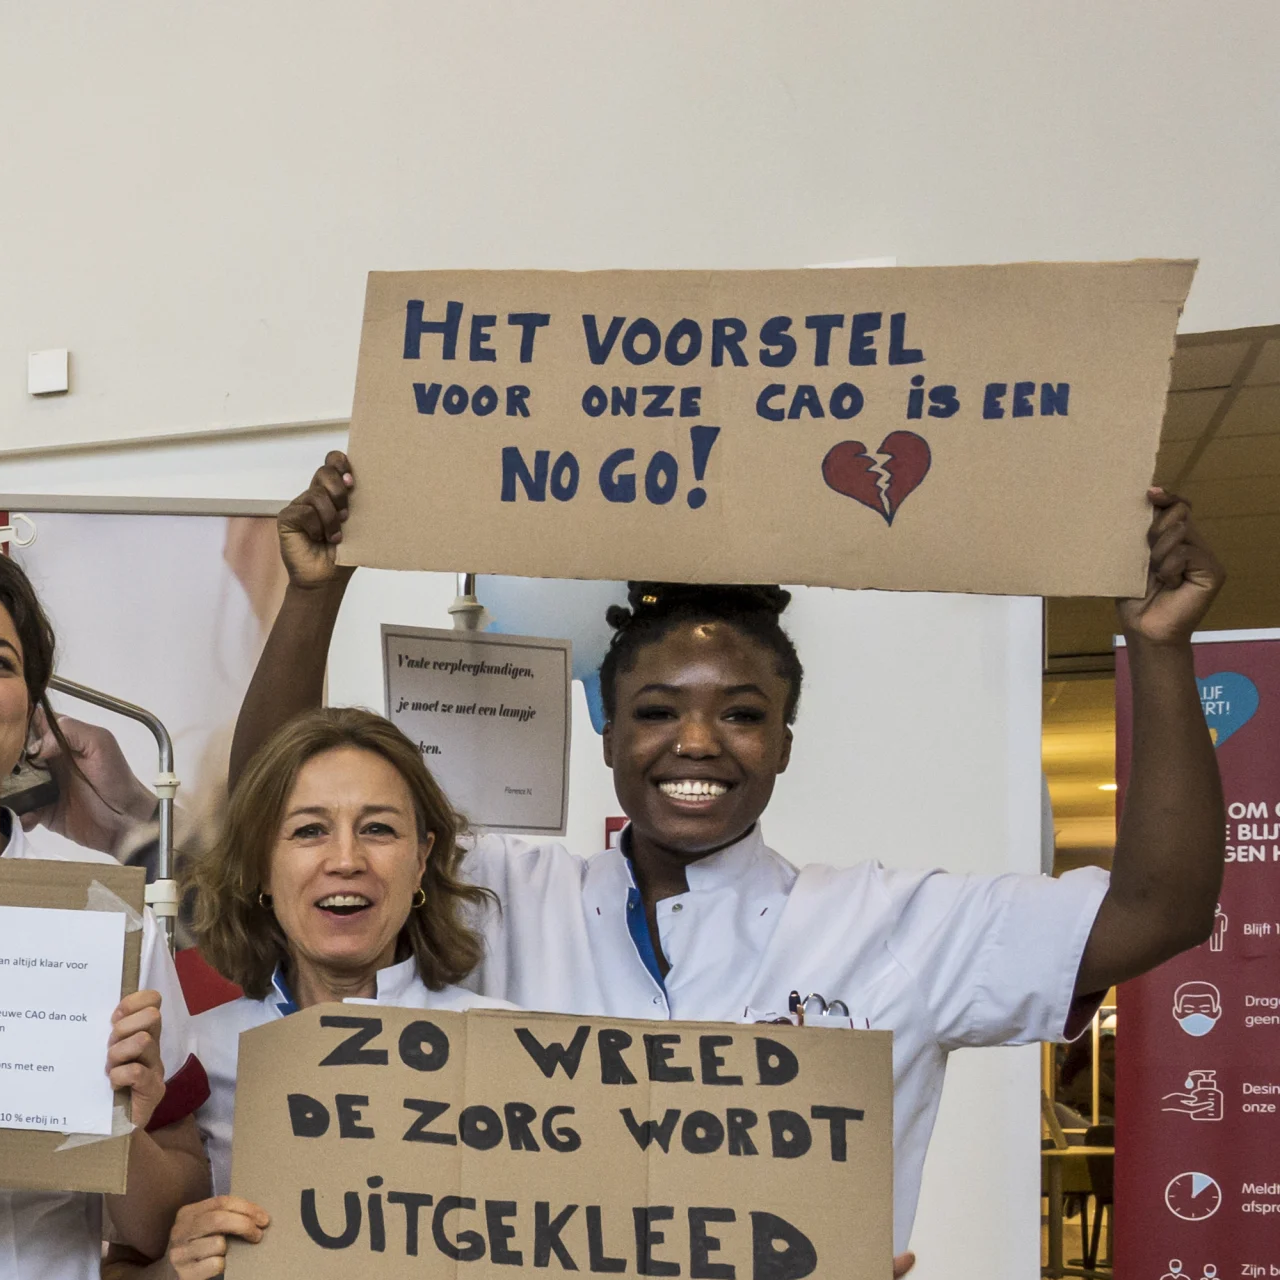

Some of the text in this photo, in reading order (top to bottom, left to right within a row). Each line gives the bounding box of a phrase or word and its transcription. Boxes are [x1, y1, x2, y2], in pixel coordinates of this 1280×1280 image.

[581, 312, 926, 367] VOORSTEL
[412, 382, 531, 418] VOOR
[581, 385, 702, 418] ONZE
[755, 382, 865, 421] CAO
[982, 383, 1070, 420] EEN
[501, 425, 721, 510] NO GO!
[398, 654, 534, 679] Vaste verpleegkundigen,
[396, 697, 536, 722] je moet ze met een lampje
[1228, 802, 1268, 819] OM
[1238, 823, 1280, 840] BLIJ
[1243, 923, 1271, 938] Blijft
[13, 957, 37, 968] altijd
[40, 958, 63, 968] klaar
[66, 961, 88, 970] voor
[25, 1010, 46, 1020] CAO
[48, 1012, 66, 1021] dan
[69, 1013, 87, 1022] ook
[1245, 1015, 1280, 1027] geen
[318, 1015, 800, 1086] ZO WREED
[14, 1062, 33, 1071] met
[36, 1064, 54, 1072] een
[1242, 1103, 1276, 1113] onze
[1, 1113, 12, 1122] 10
[14, 1114, 23, 1122] %
[25, 1115, 47, 1125] erbij
[50, 1116, 59, 1124] in
[287, 1093, 864, 1162] DE ZORG WORDT
[1241, 1263, 1266, 1278] Zijn
